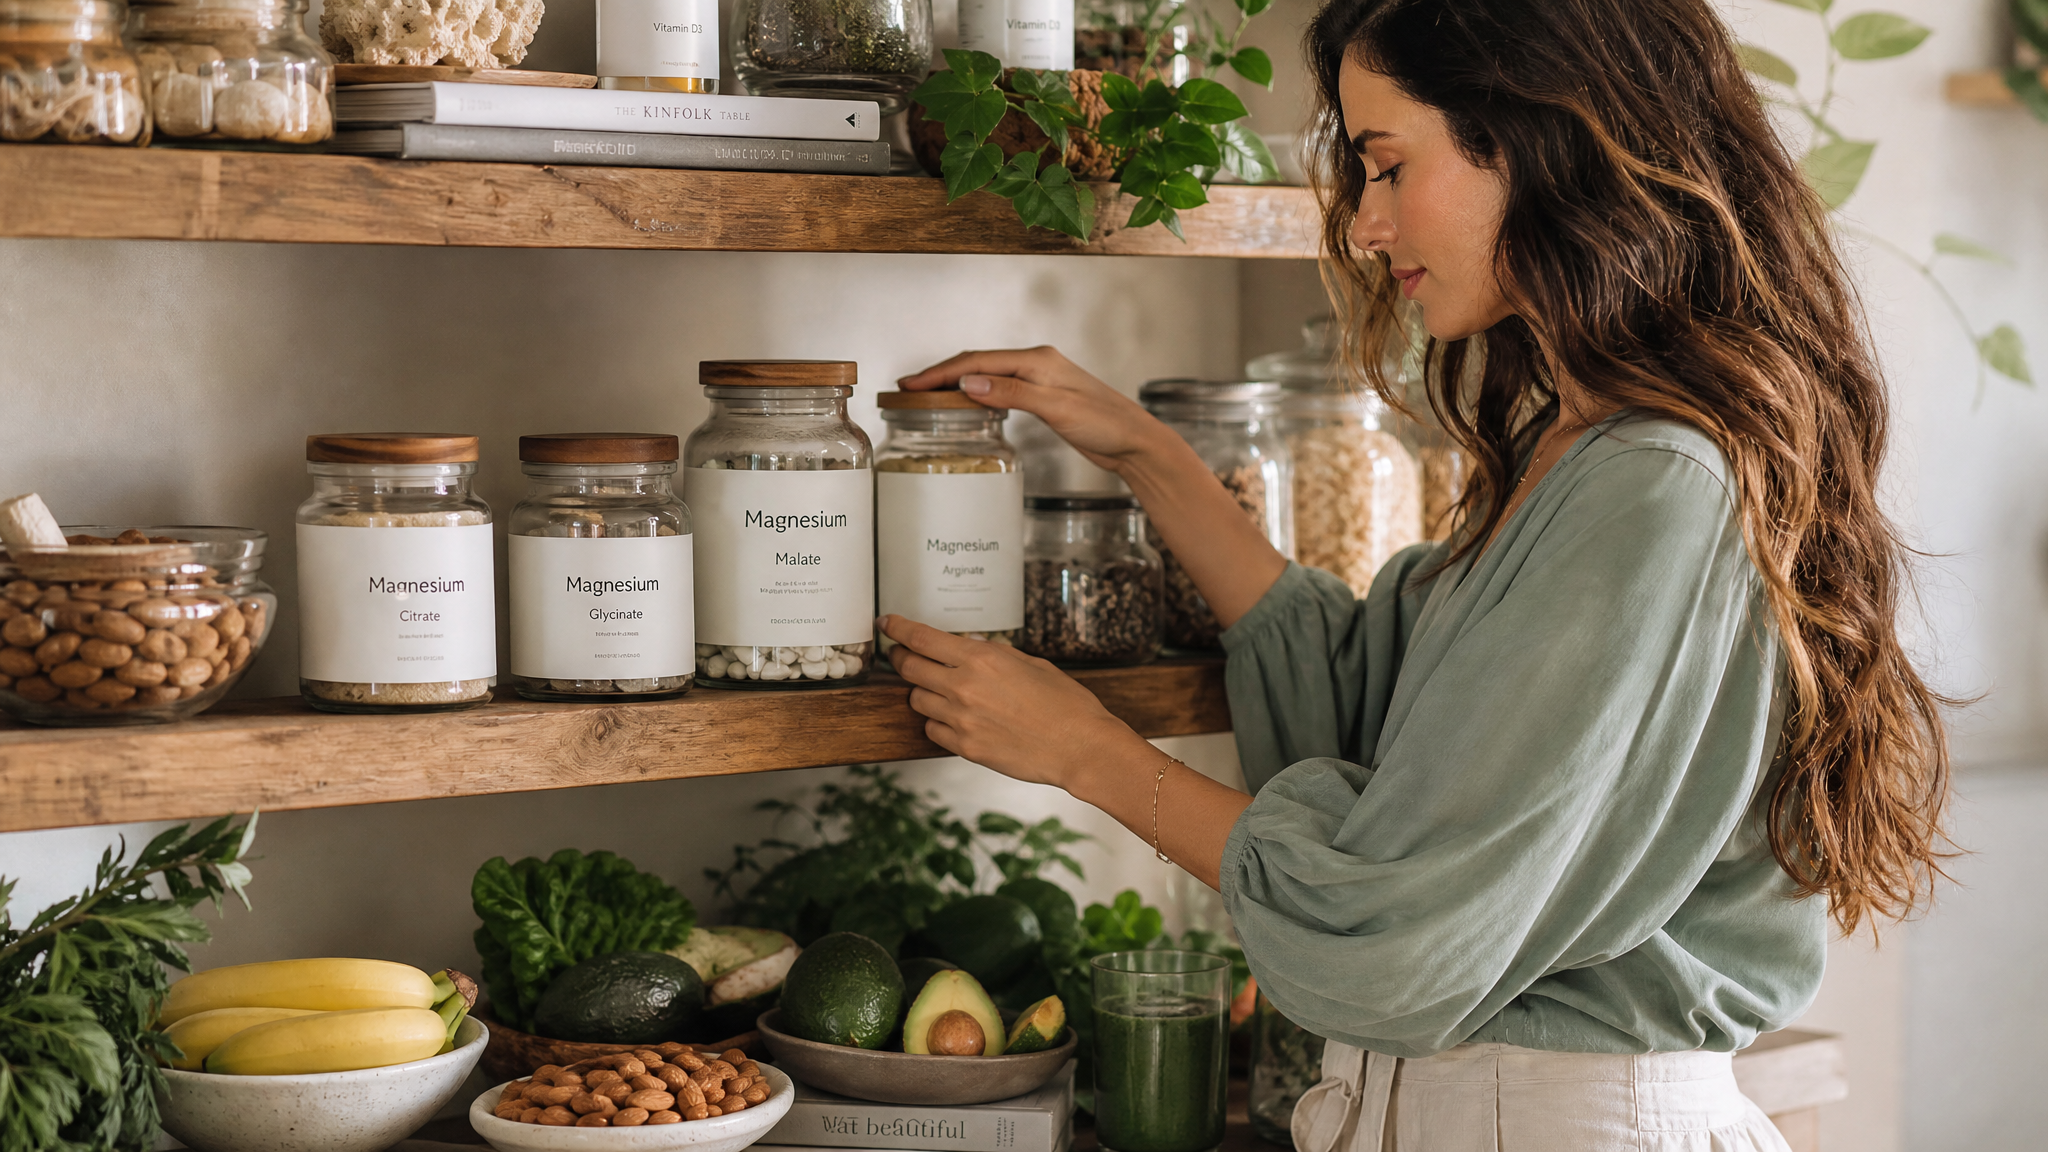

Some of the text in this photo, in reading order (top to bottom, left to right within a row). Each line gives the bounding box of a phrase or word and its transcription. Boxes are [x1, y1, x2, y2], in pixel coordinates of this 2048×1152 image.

[653, 22, 703, 34] Vitamin D3
[1006, 19, 1047, 30] Vitamin
[614, 105, 751, 121] THE KINFOLK TABLE
[744, 509, 848, 533] Magnesium
[926, 538, 1000, 556] Magnesium
[775, 552, 821, 566] Malate
[942, 564, 985, 578] Arginate
[369, 576, 465, 595] Magnesium
[566, 576, 659, 597] Magnesium
[399, 609, 441, 622] Citrate
[589, 608, 643, 623] Glycinate
